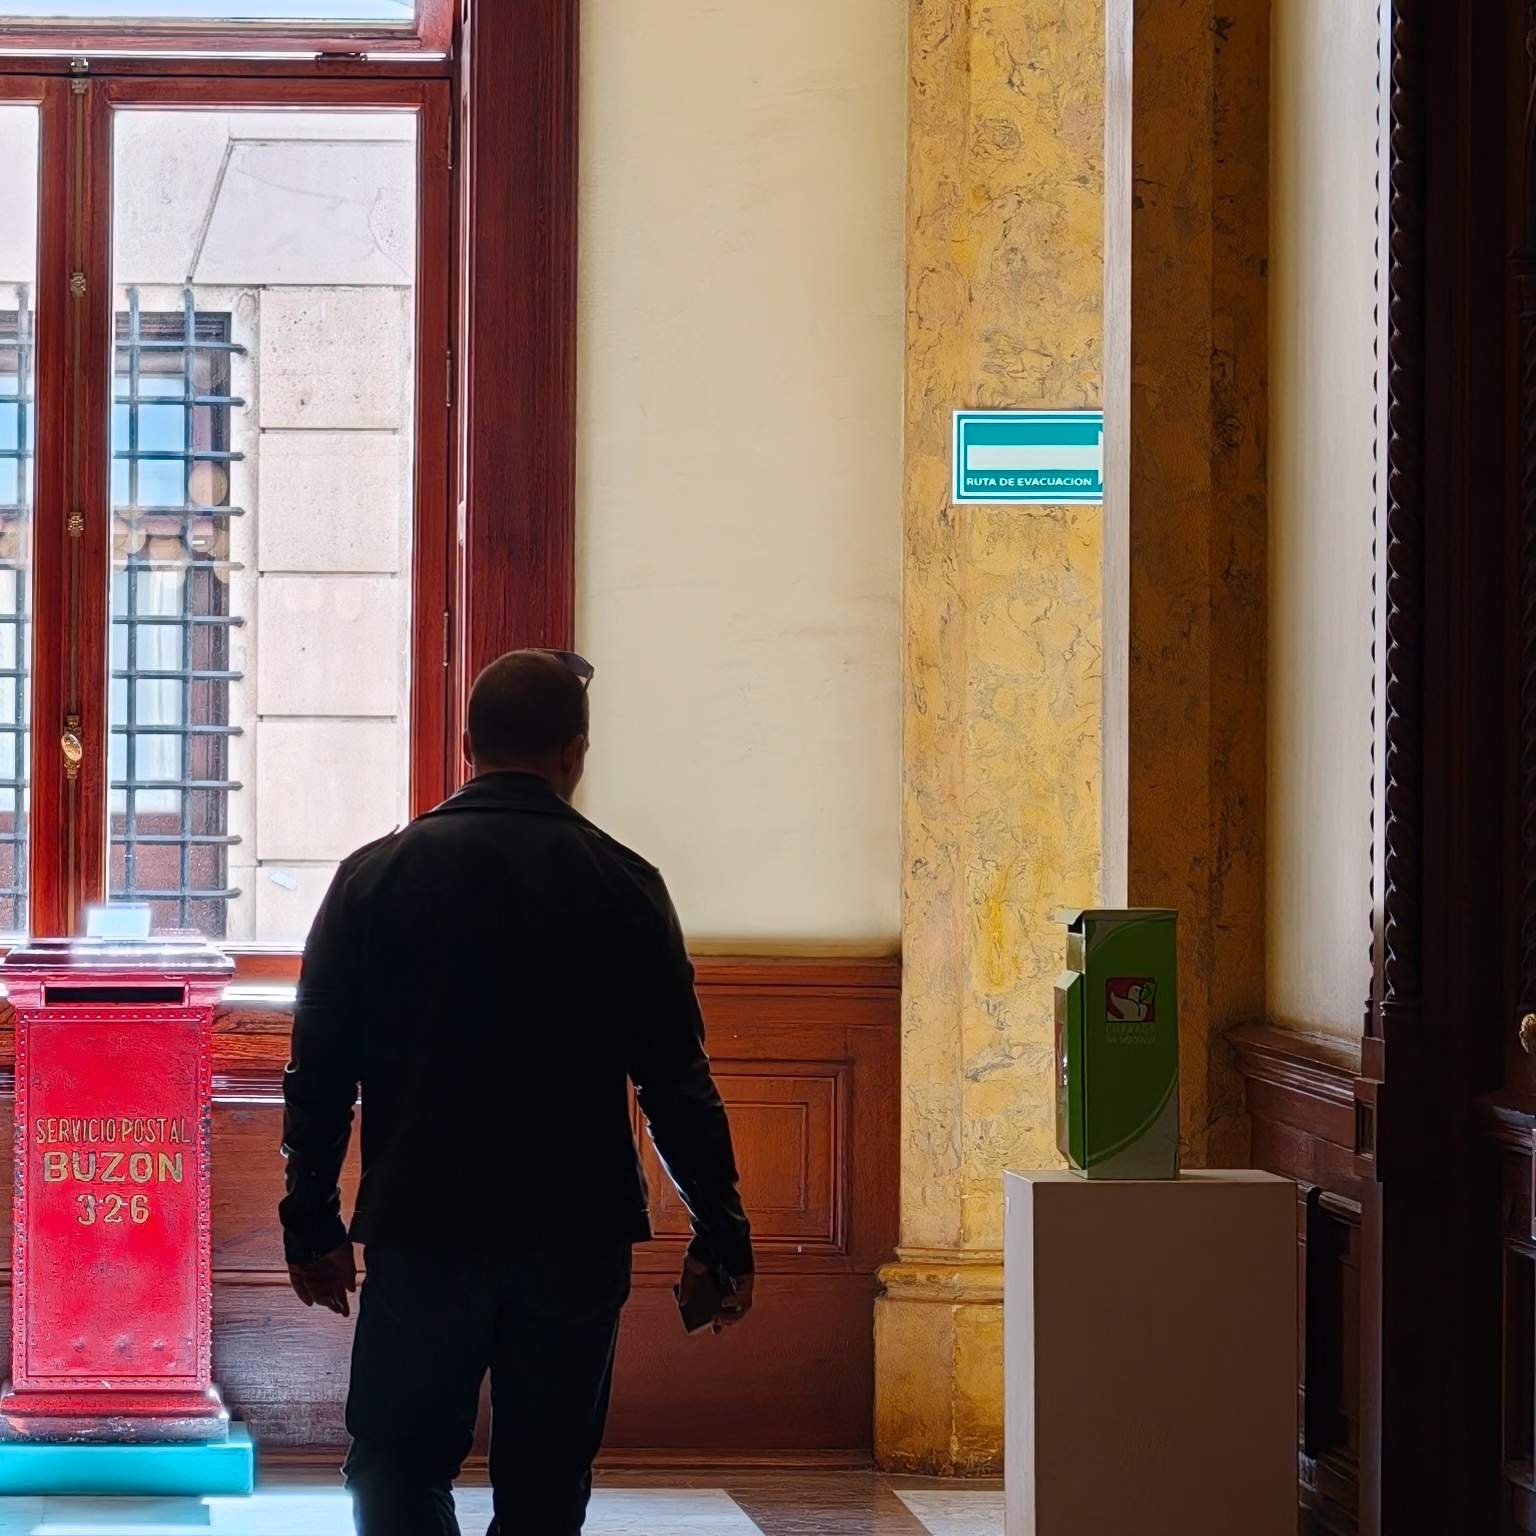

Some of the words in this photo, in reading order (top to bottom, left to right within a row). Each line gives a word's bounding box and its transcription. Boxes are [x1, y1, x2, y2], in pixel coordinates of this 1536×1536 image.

[966, 477, 997, 486] RUTA
[999, 477, 1015, 486] DE
[1017, 477, 1092, 486] EVACUACION
[36, 1118, 116, 1143] SERVICIO
[121, 1117, 192, 1143] POSTAL
[43, 1151, 183, 1183] BUZON
[77, 1193, 149, 1225] 326
